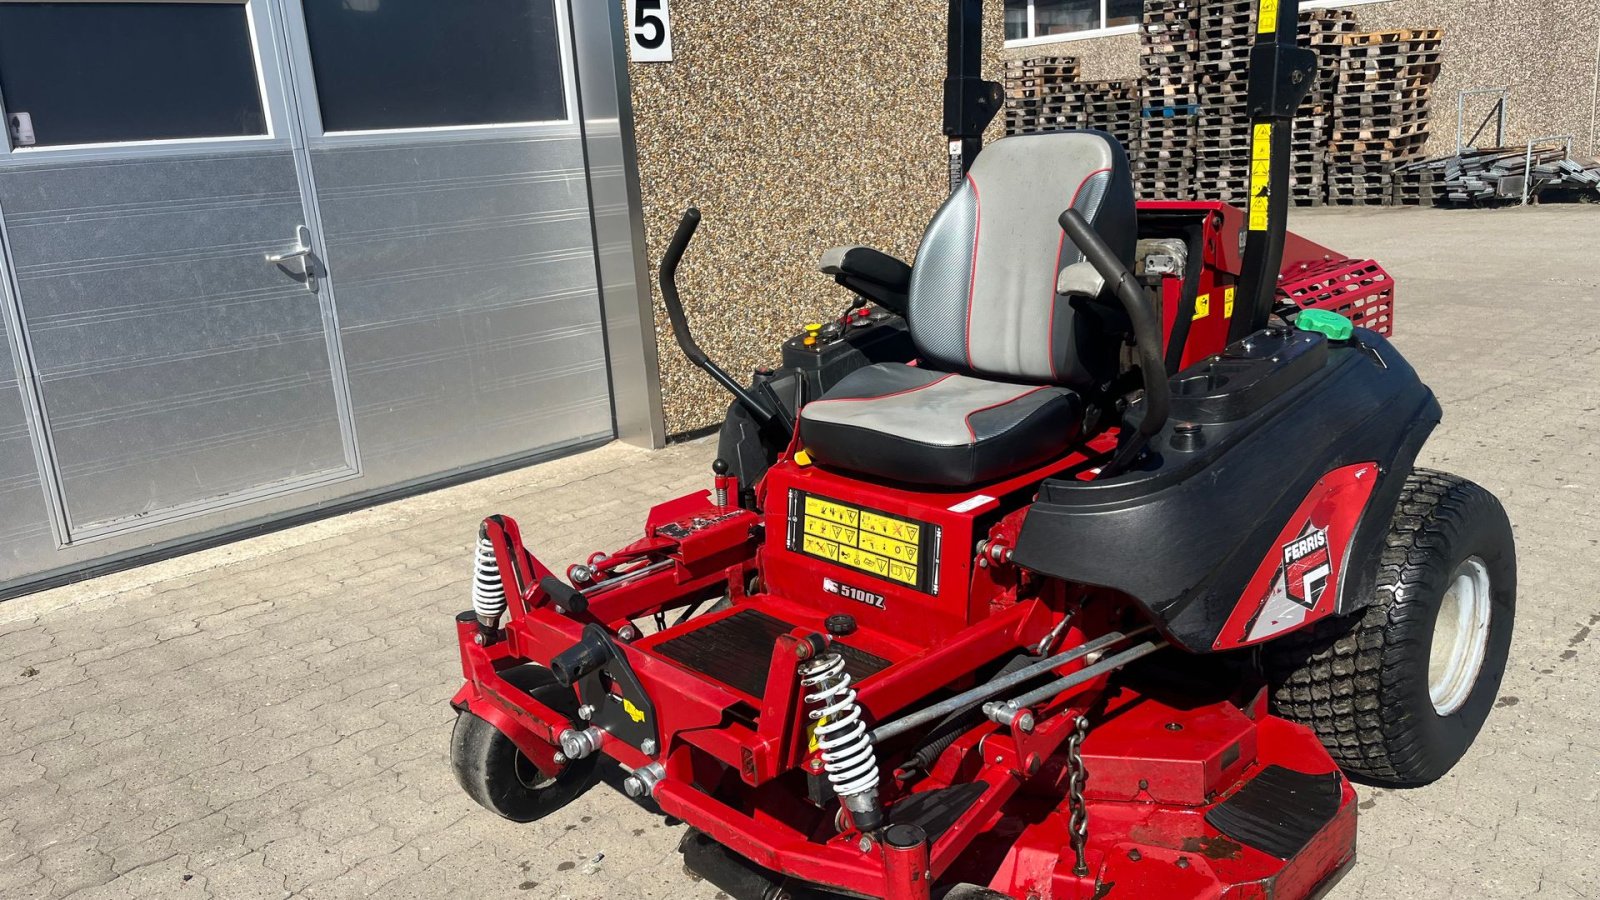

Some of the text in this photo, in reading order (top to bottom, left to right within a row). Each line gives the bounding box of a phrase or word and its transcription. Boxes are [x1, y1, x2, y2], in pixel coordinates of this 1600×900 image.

[634, 0, 665, 49] 5
[1284, 531, 1325, 563] FERRIS
[841, 584, 884, 608] 5100Z
